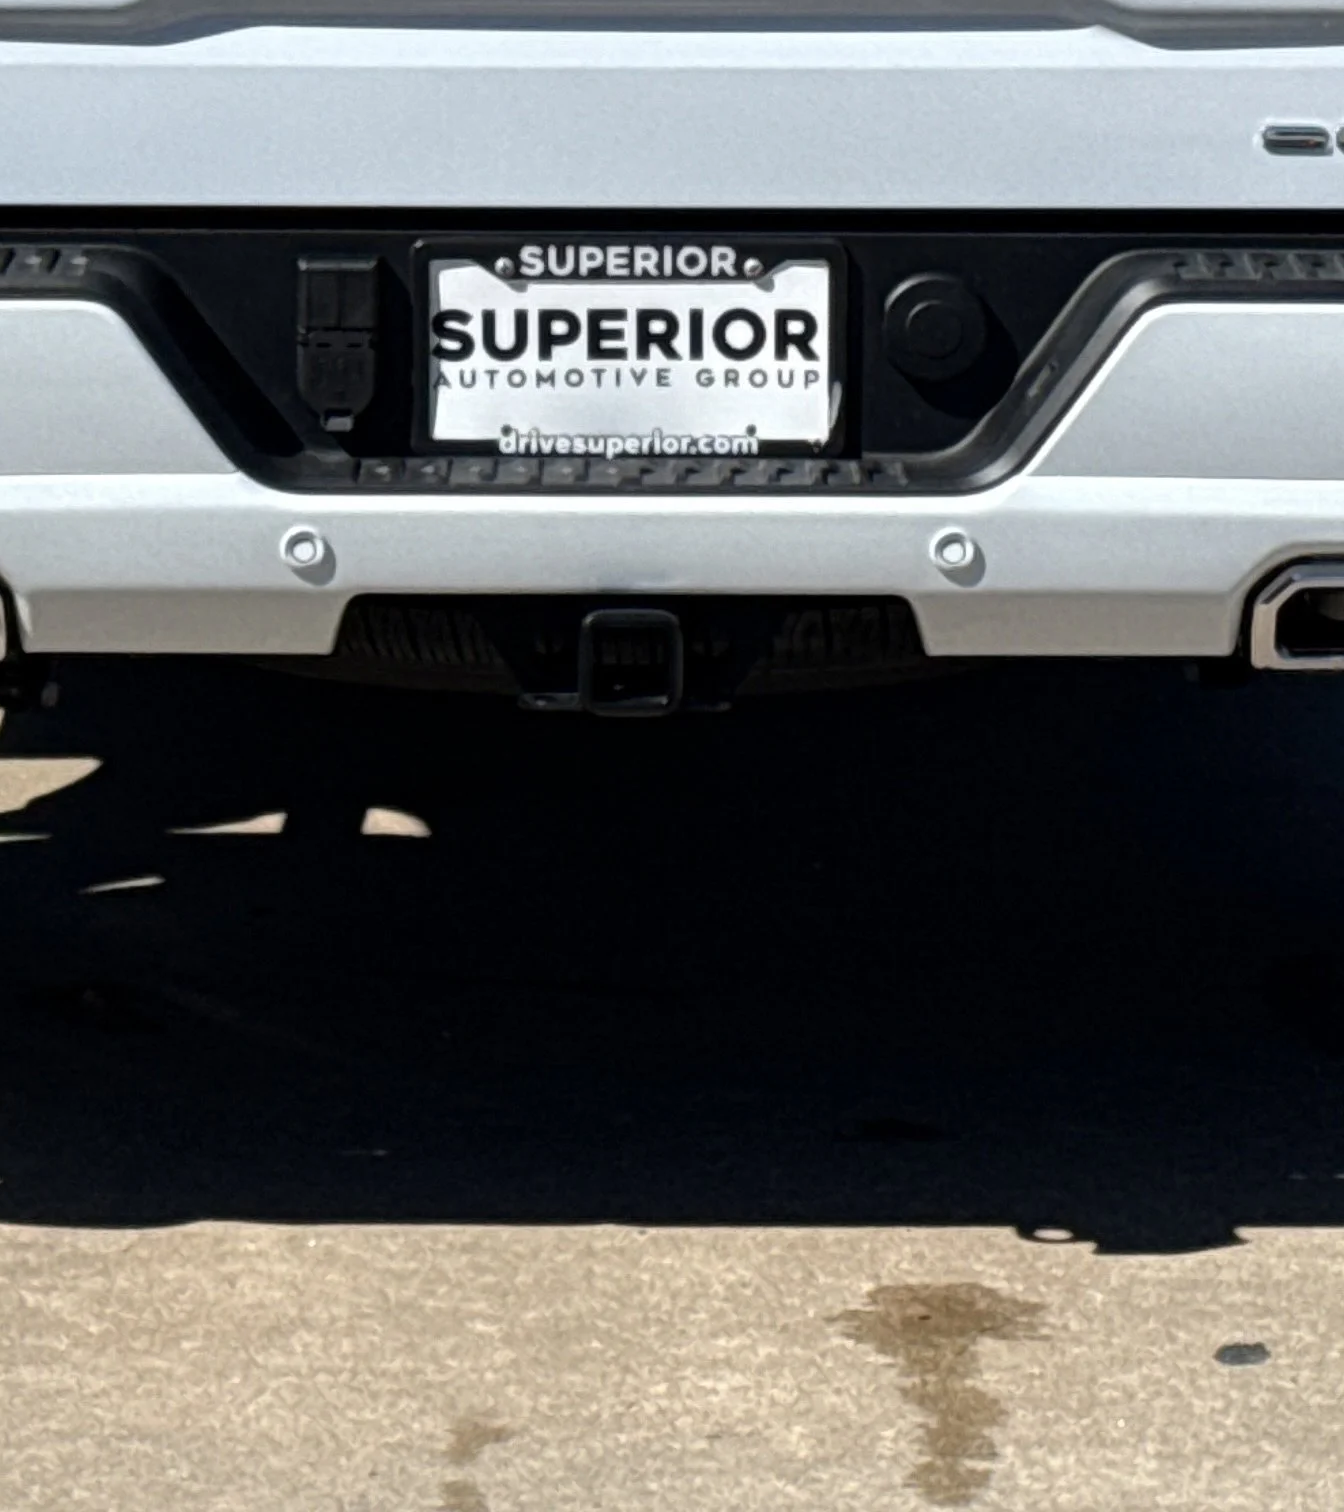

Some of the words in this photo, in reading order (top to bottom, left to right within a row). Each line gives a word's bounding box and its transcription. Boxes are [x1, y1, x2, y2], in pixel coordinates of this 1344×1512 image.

[519, 245, 738, 277] SUPERIOR
[431, 308, 820, 362] SUPERIOR
[434, 368, 672, 389] AUTOMOTIVE
[695, 368, 820, 389] GROUP
[499, 428, 759, 460] drivesuperior.com
